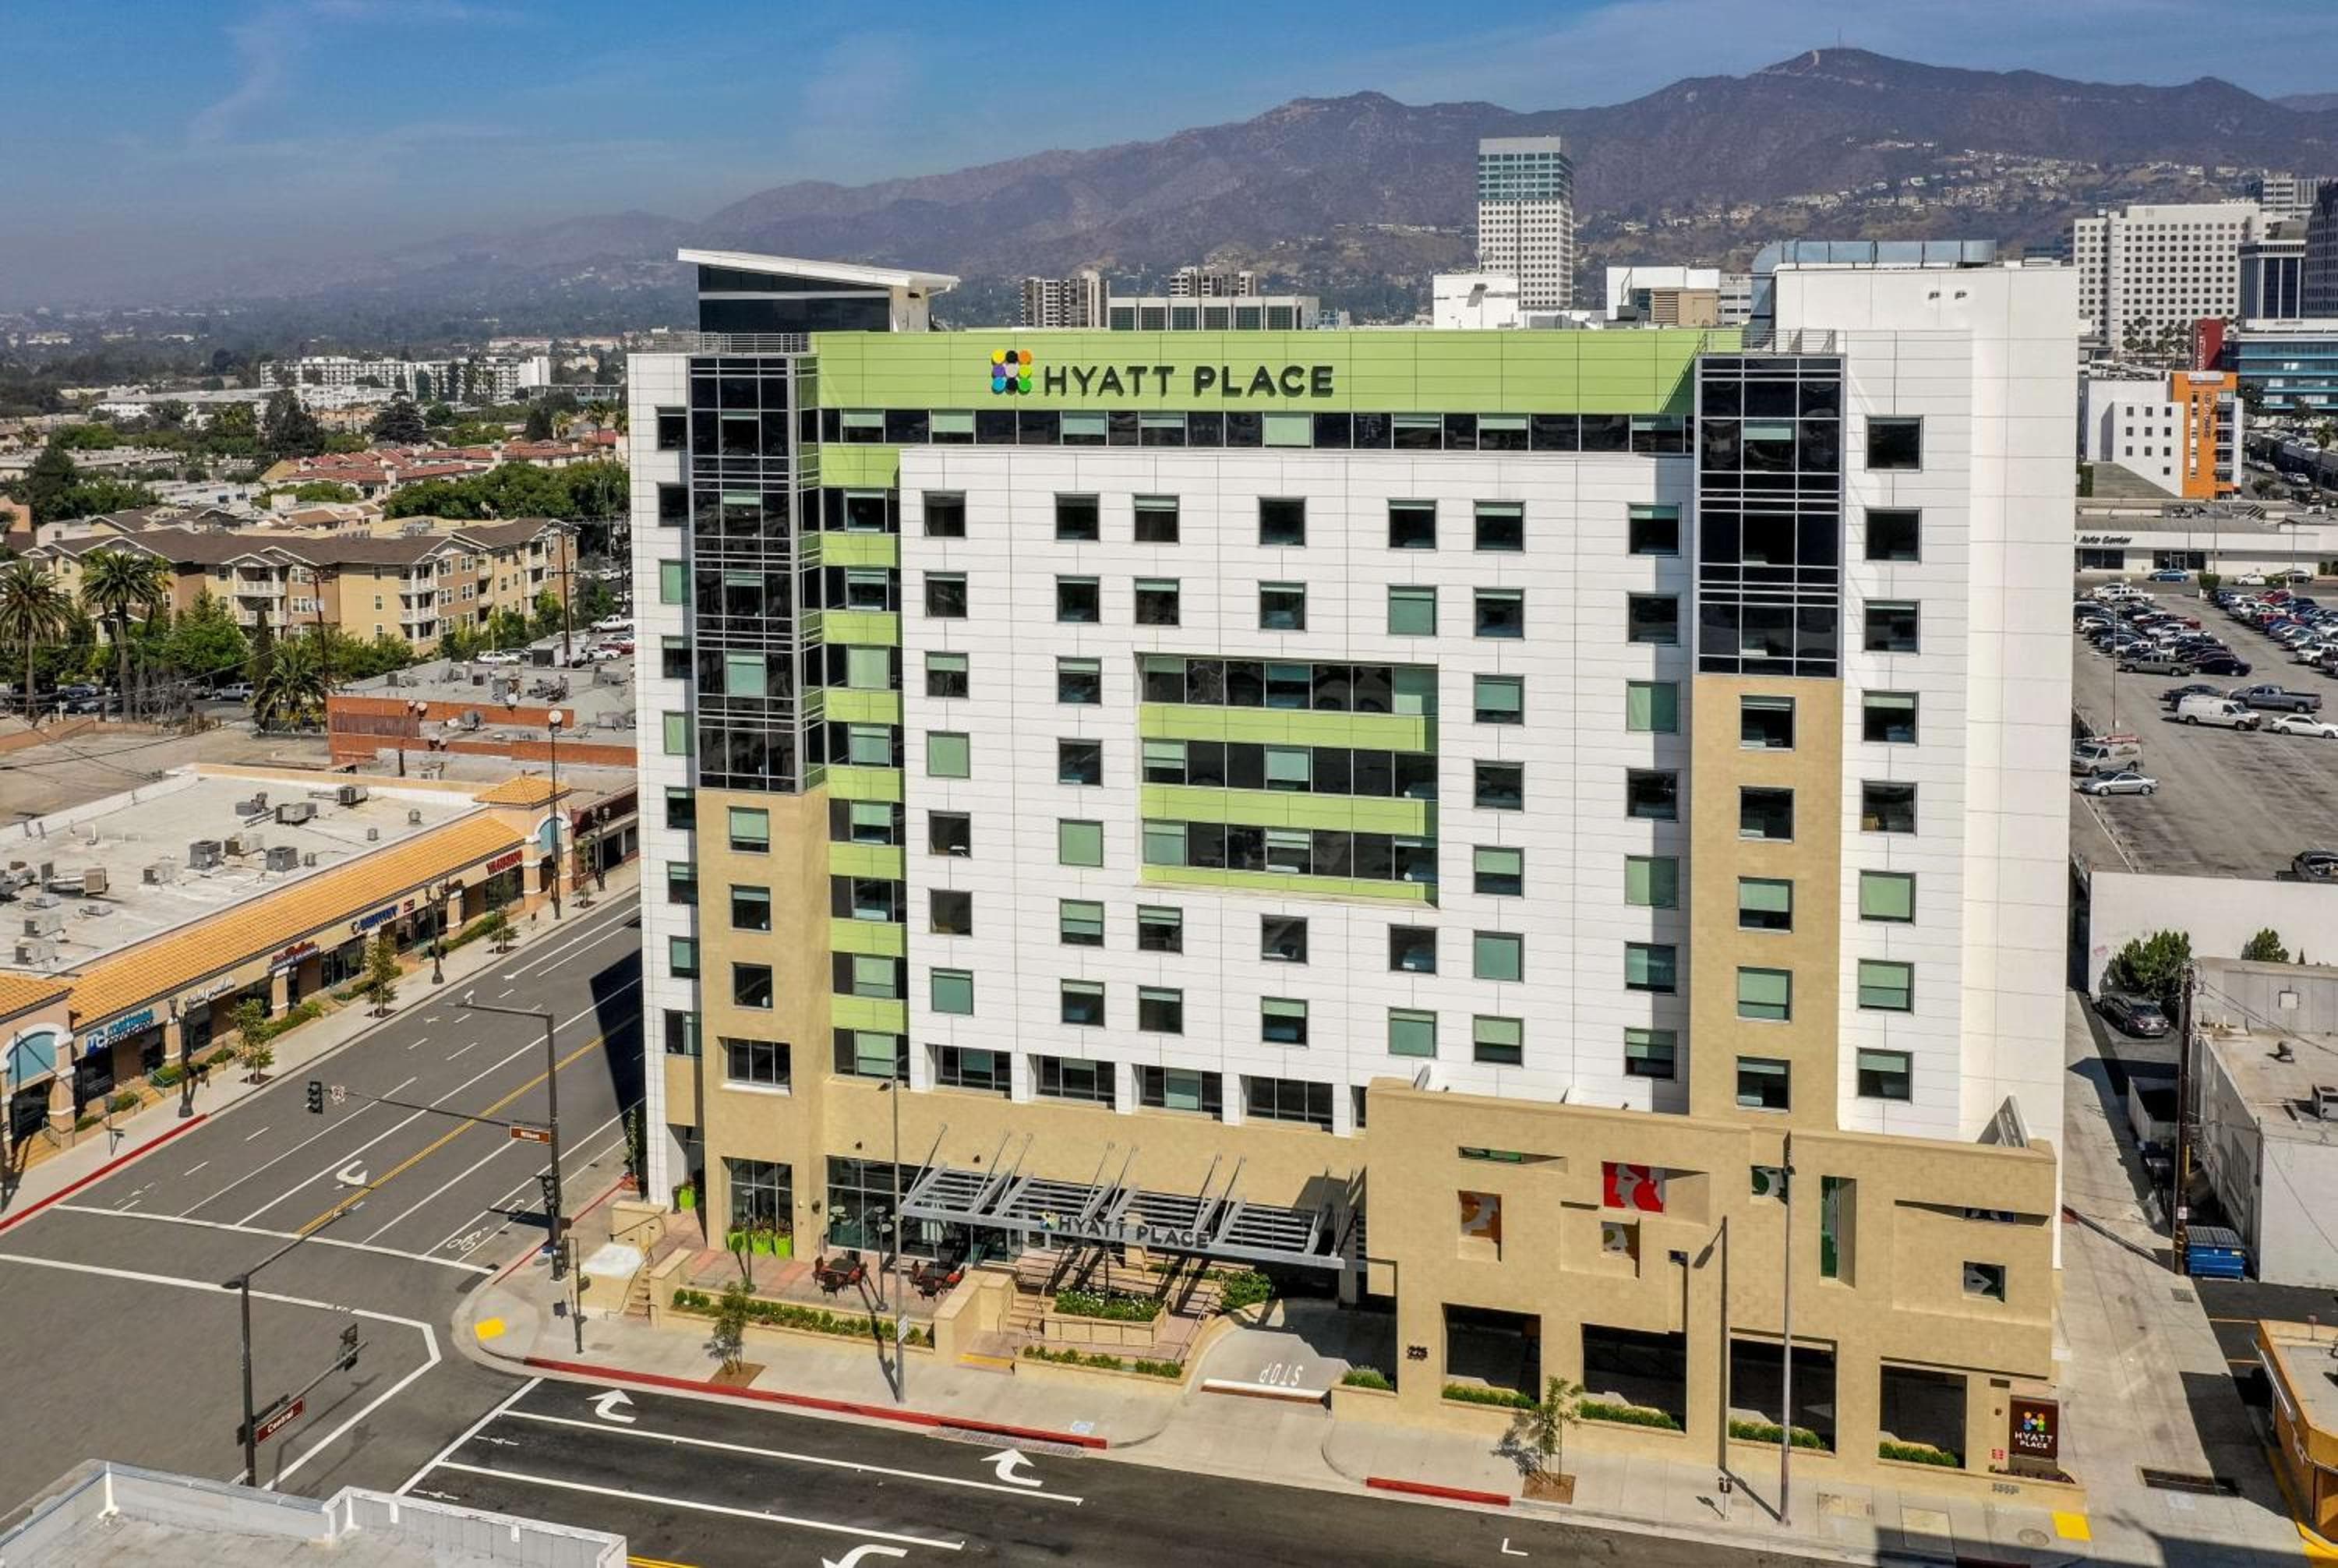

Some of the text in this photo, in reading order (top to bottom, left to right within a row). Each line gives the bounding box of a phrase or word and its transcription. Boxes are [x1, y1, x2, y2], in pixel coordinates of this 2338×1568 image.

[1044, 366, 1333, 397] HYATT PLACE
[2079, 535, 2132, 544] Auto Center
[1058, 1215, 1210, 1248] HYATT PLACE
[1259, 1361, 1303, 1386] STOP
[267, 1409, 294, 1433] Central
[2015, 1432, 2053, 1443] HYATT
